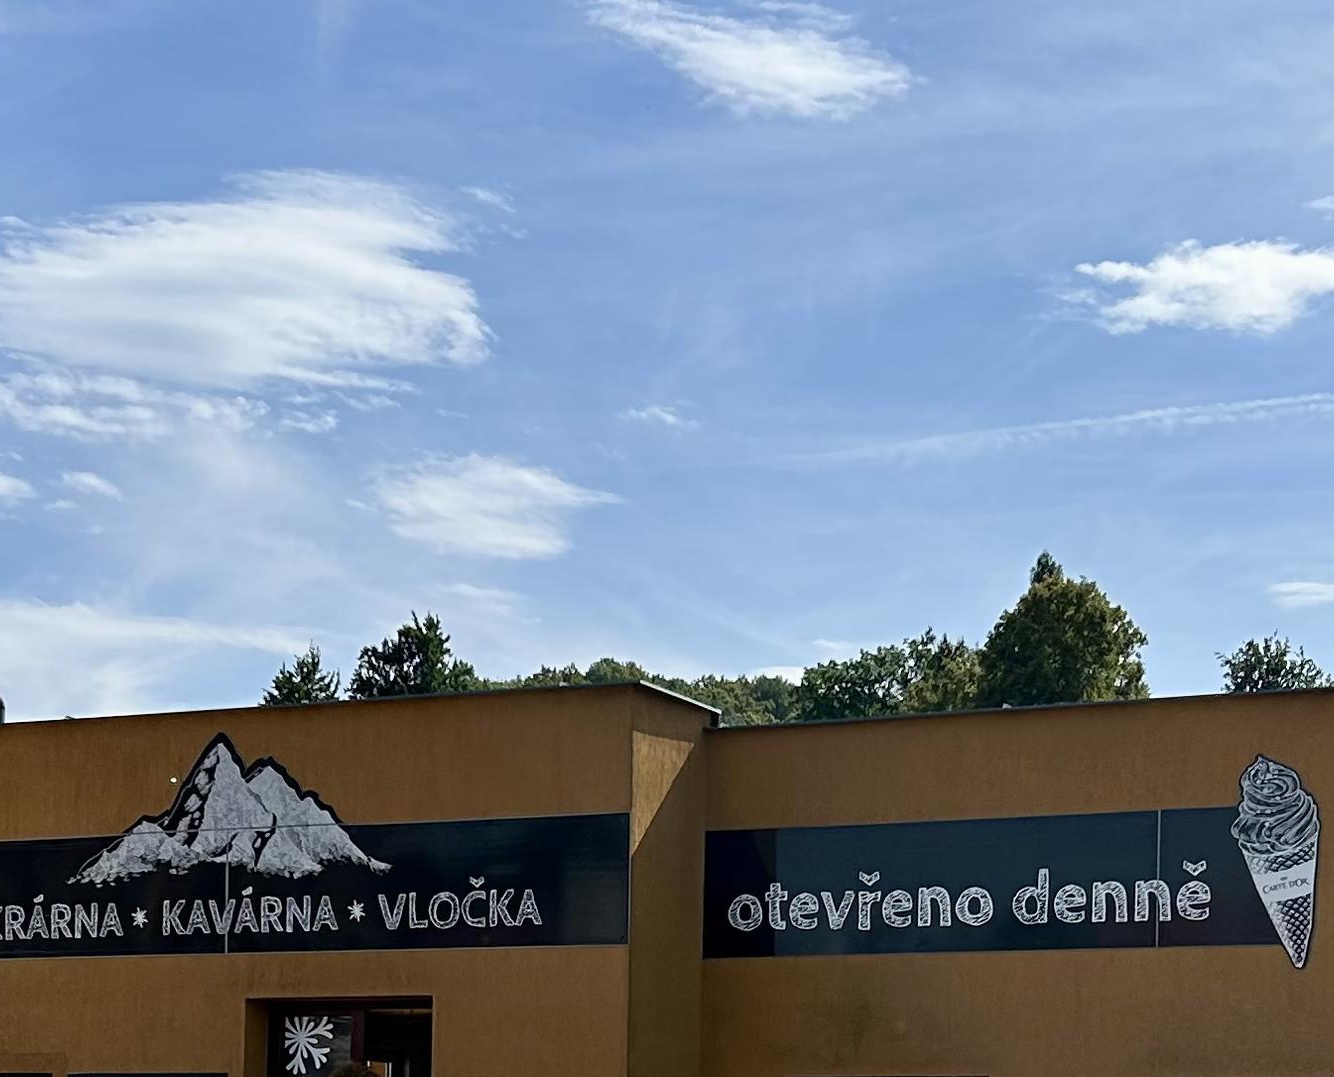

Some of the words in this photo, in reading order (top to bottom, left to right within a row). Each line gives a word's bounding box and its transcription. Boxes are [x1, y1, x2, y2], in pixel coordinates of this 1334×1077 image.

[162, 885, 340, 938] KAVÁRNA
[378, 875, 544, 931] VLOČKA
[727, 870, 994, 932] otevřeno
[1012, 859, 1213, 925] denně
